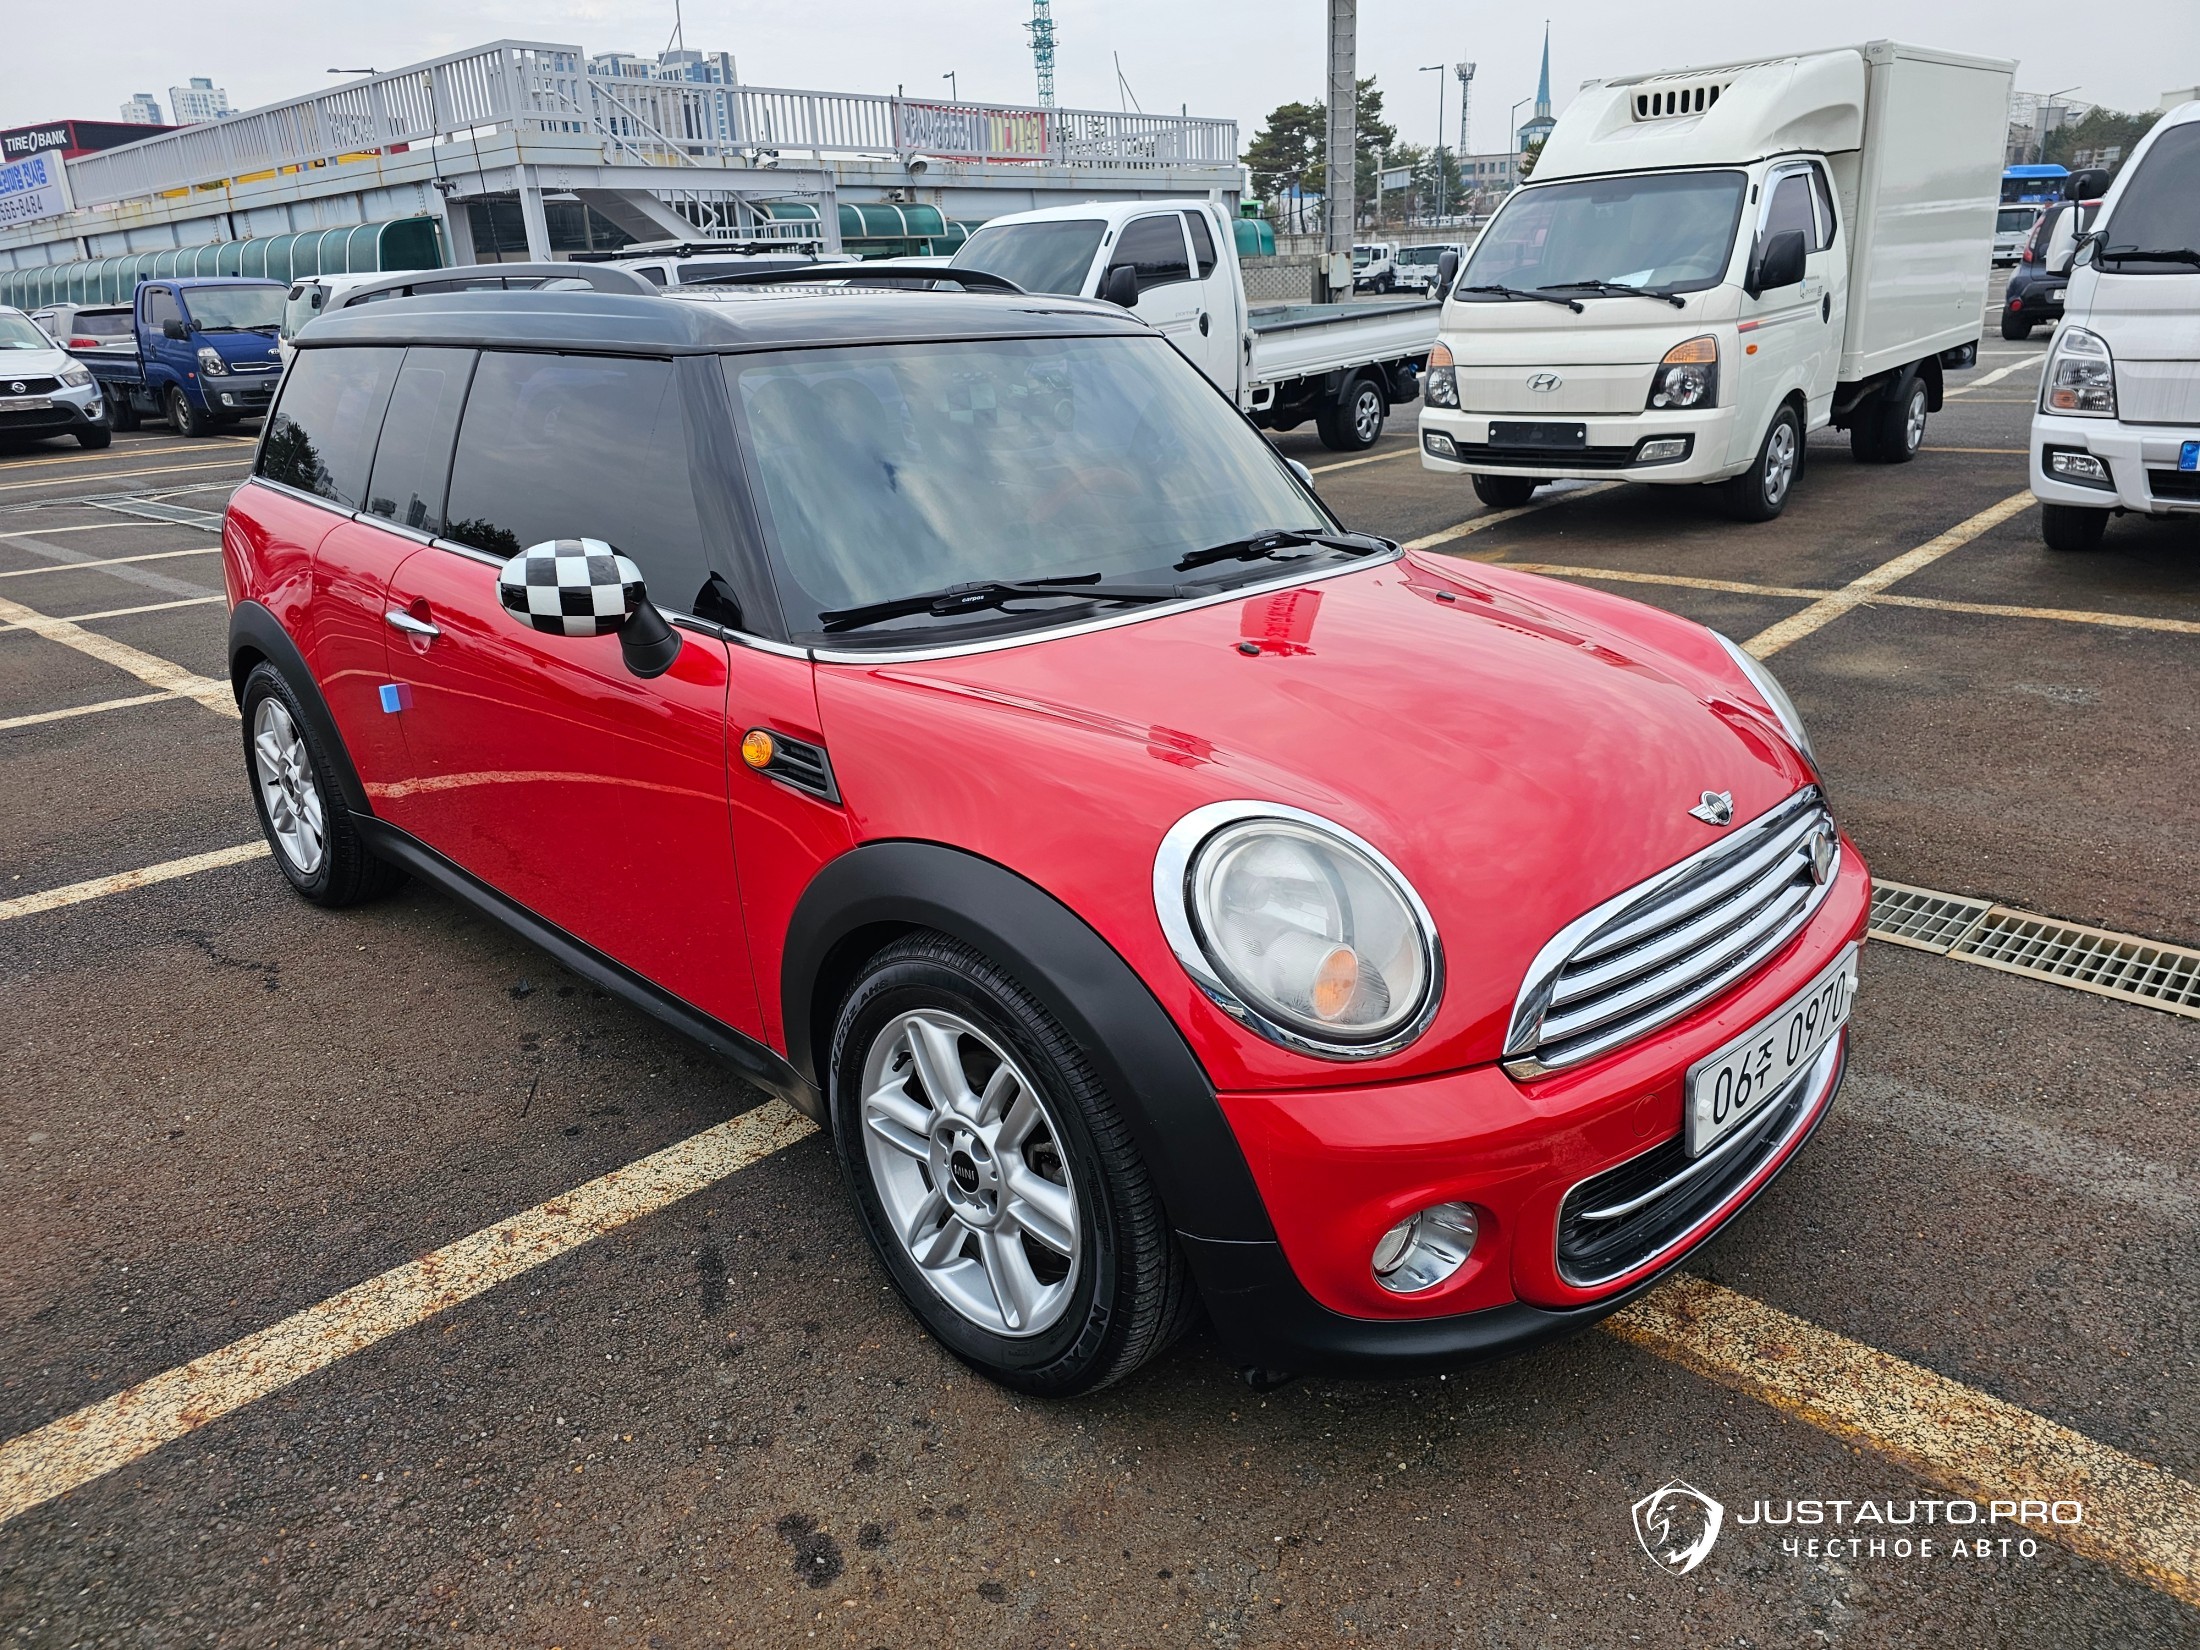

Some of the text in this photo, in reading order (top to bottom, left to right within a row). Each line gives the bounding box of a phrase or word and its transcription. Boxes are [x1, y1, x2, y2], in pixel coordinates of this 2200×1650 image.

[1713, 970, 1846, 1124] 06주 0970
[954, 1164, 975, 1181] MINI
